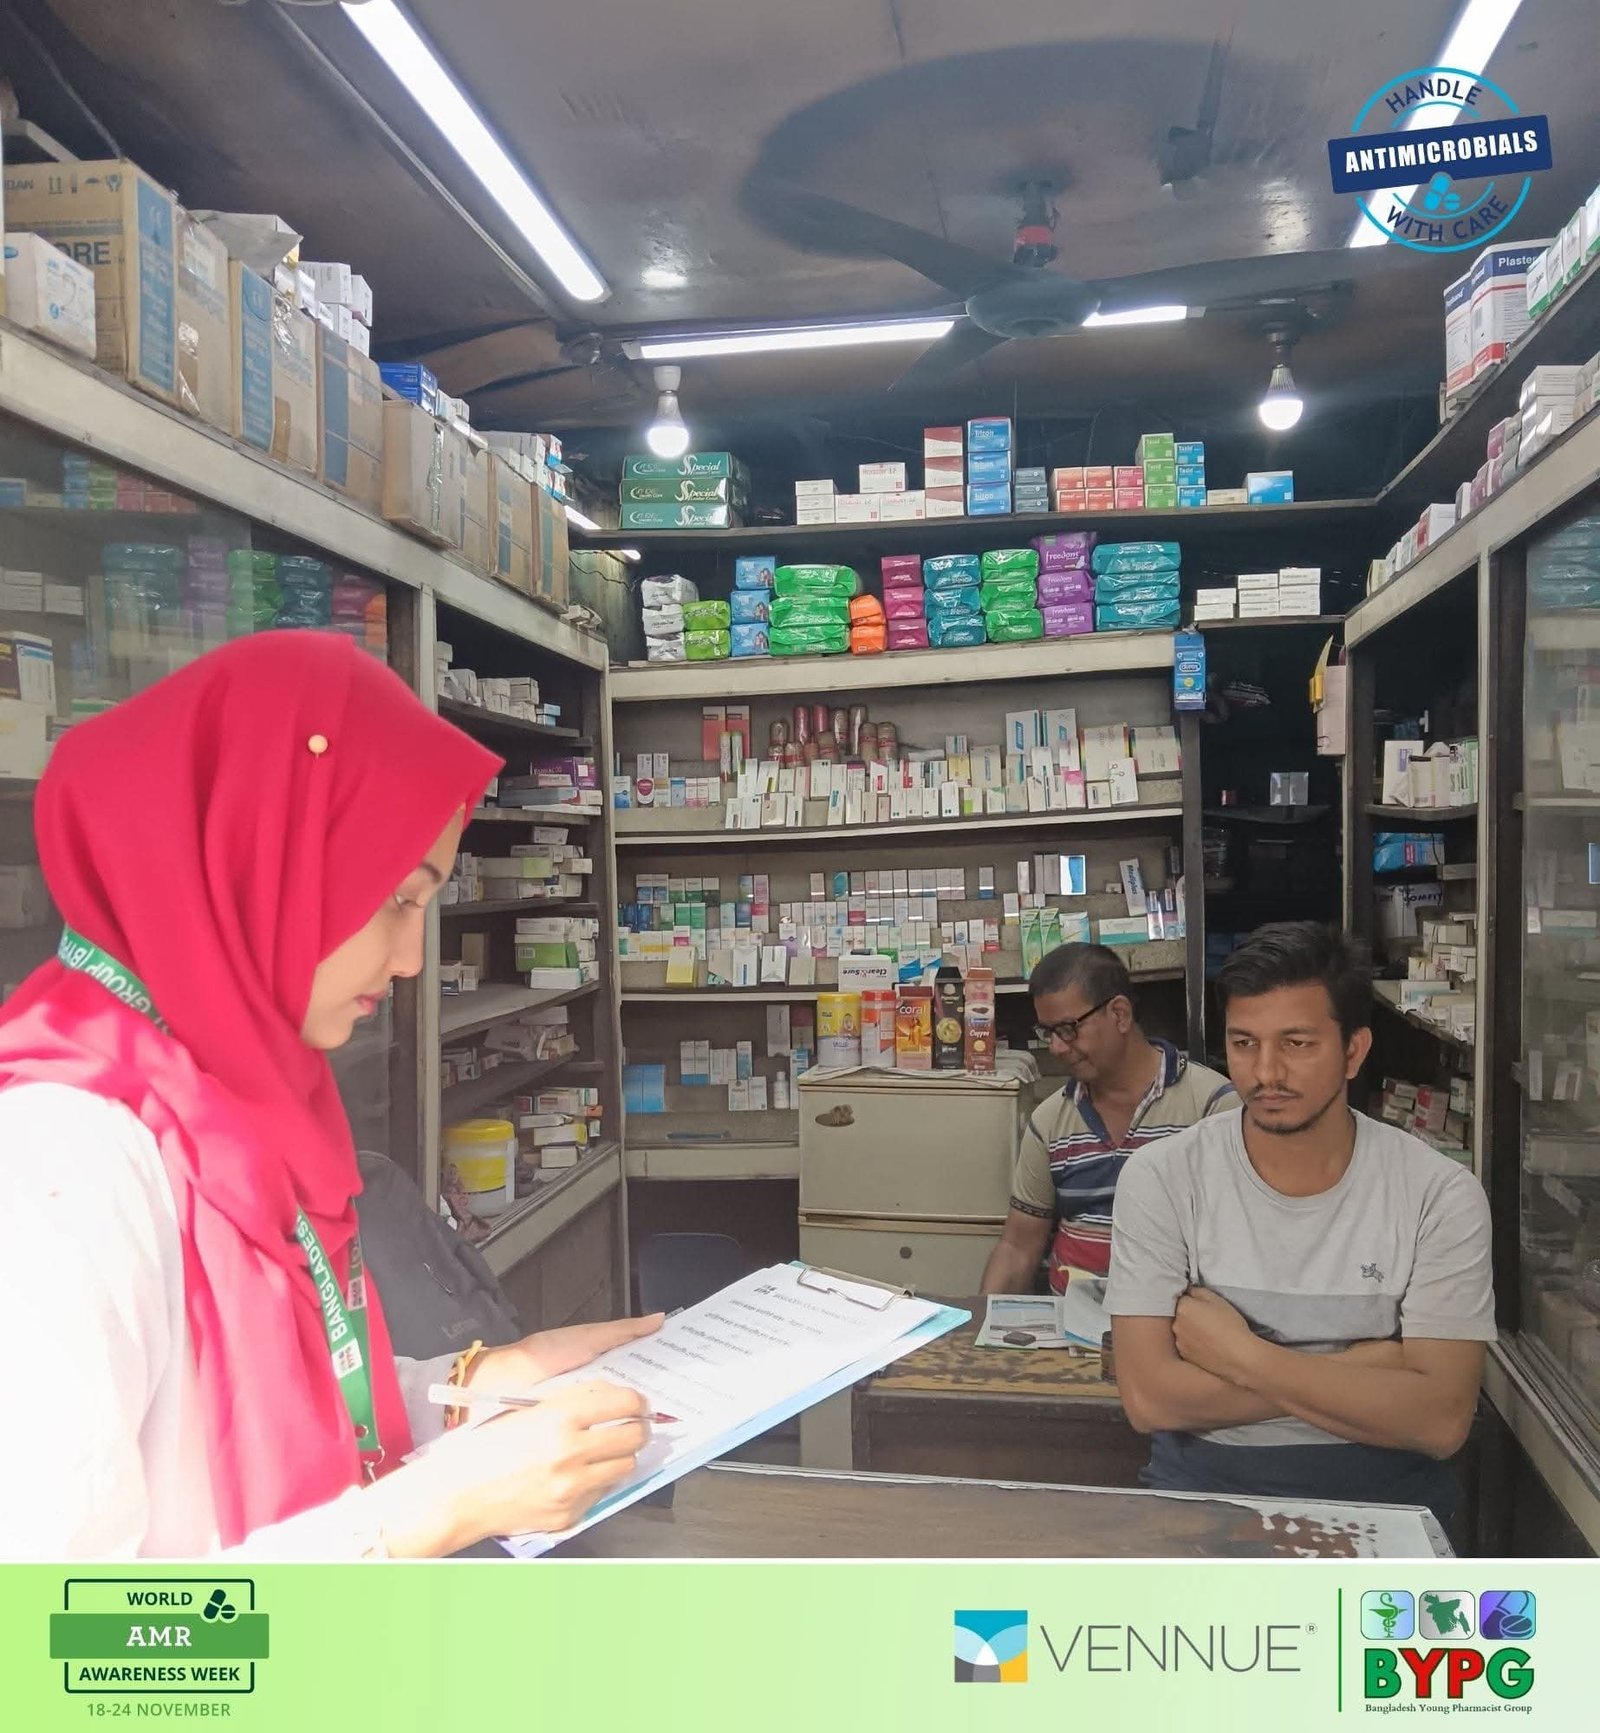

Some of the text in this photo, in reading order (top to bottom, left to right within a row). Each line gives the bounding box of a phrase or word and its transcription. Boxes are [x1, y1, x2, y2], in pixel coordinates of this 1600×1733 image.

[86, 962, 152, 1013] GROUP
[899, 1005, 926, 1015] coral
[296, 1214, 348, 1342] BANGLADES
